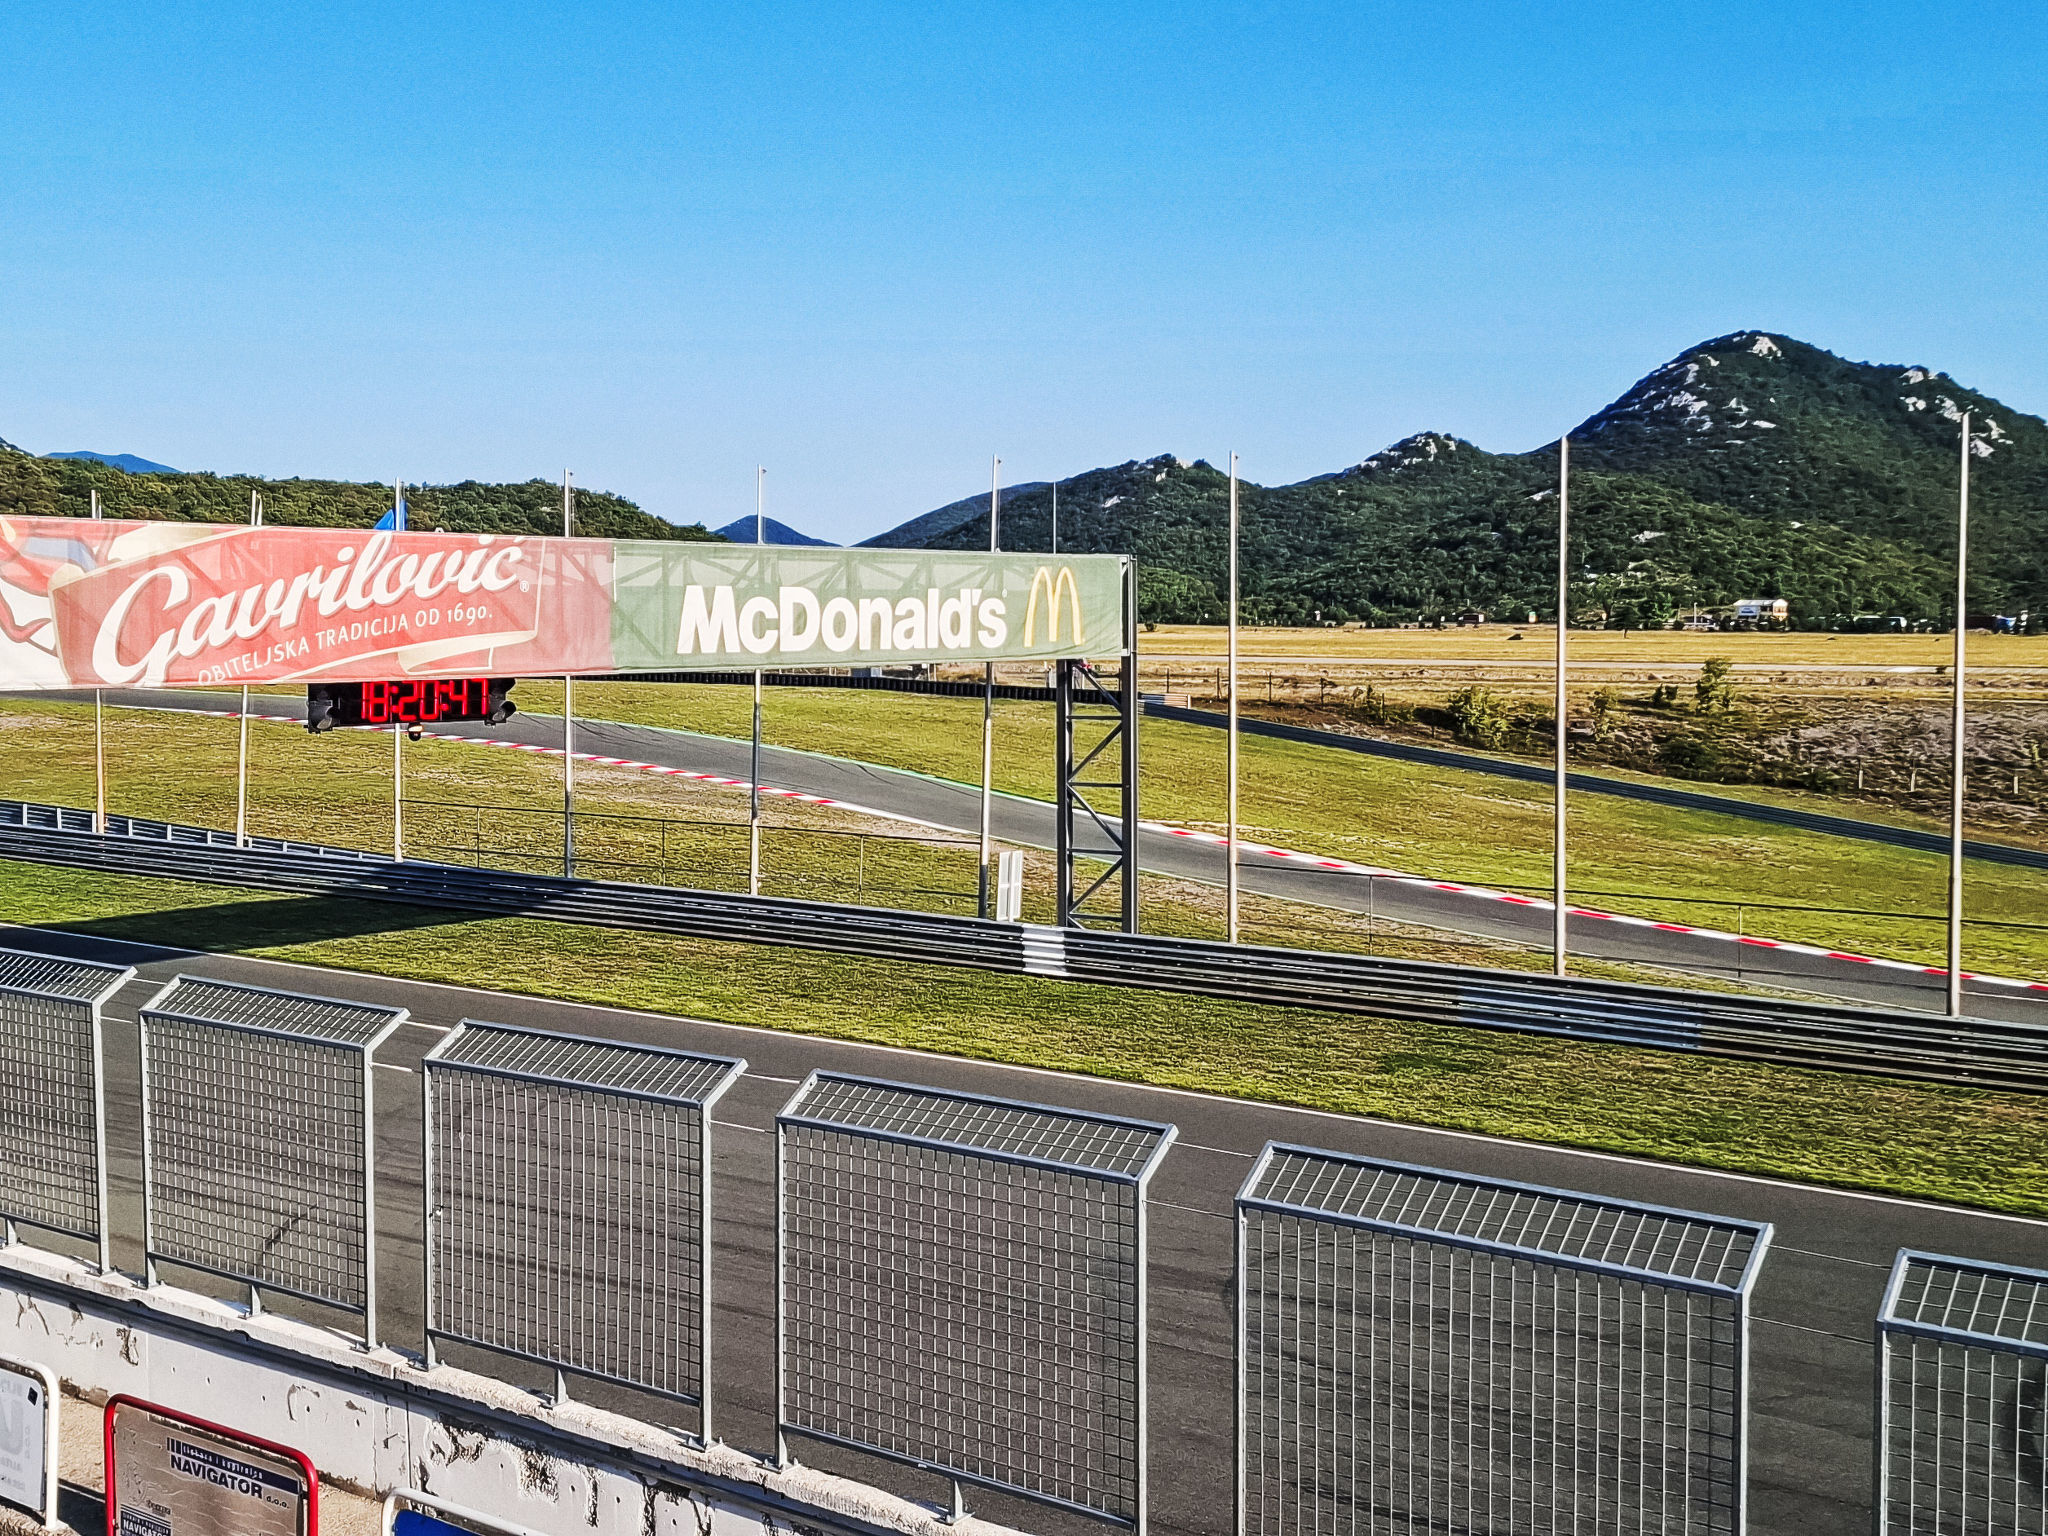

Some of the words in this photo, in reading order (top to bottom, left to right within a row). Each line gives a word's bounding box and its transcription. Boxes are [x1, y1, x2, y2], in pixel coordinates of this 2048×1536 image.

[92, 531, 525, 688] Gavrilović
[198, 635, 310, 686] OBITELJSKA
[315, 614, 409, 650] TRADICIJA
[415, 607, 440, 628] OD
[447, 602, 493, 627] 1690.
[676, 584, 1008, 655] McDonald's
[361, 677, 489, 723] 18:20:47
[170, 1454, 263, 1499] NAVIGATOR
